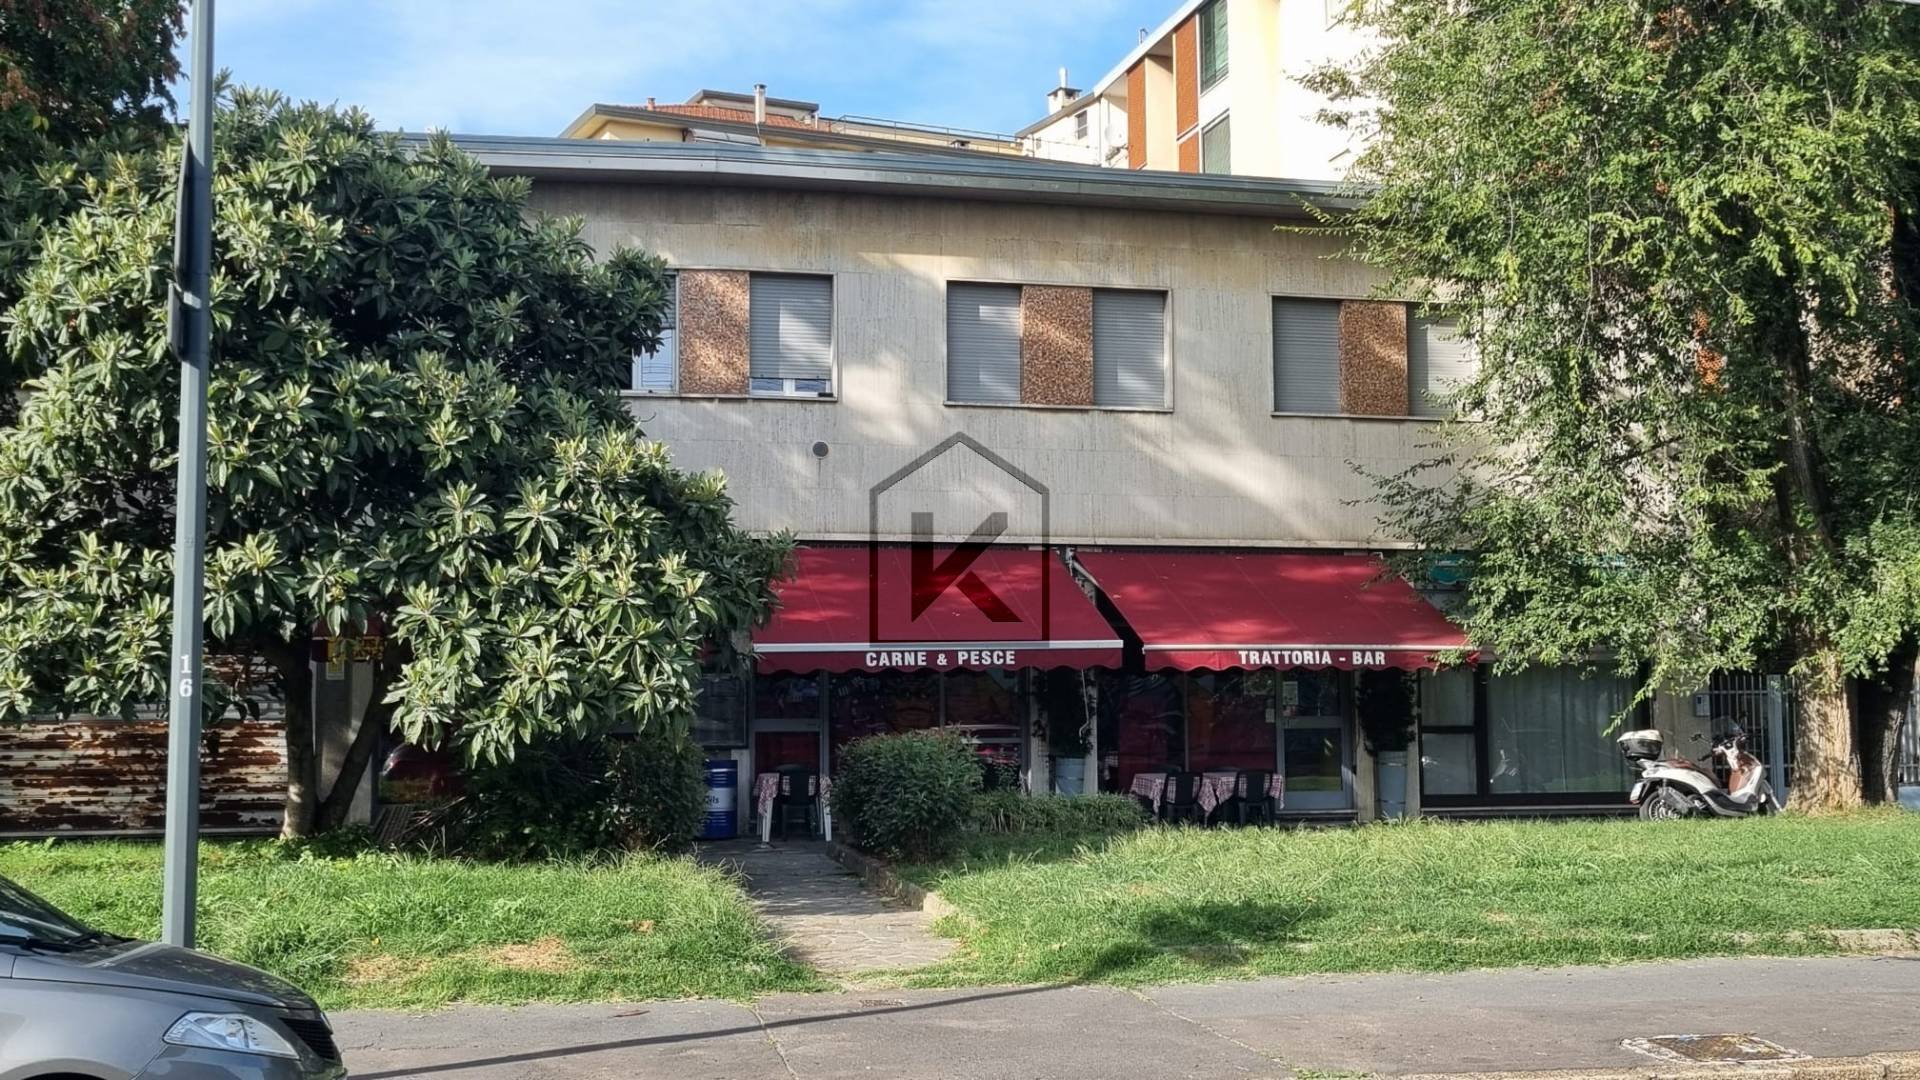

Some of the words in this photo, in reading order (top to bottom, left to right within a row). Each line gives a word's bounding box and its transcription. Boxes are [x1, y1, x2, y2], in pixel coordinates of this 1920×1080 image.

[865, 651, 927, 667] CARNE
[936, 653, 948, 666] &
[957, 650, 1016, 665] PESCE
[1238, 650, 1332, 665] TRATTORIA
[1352, 651, 1386, 665] BAR
[180, 654, 192, 697] 16
